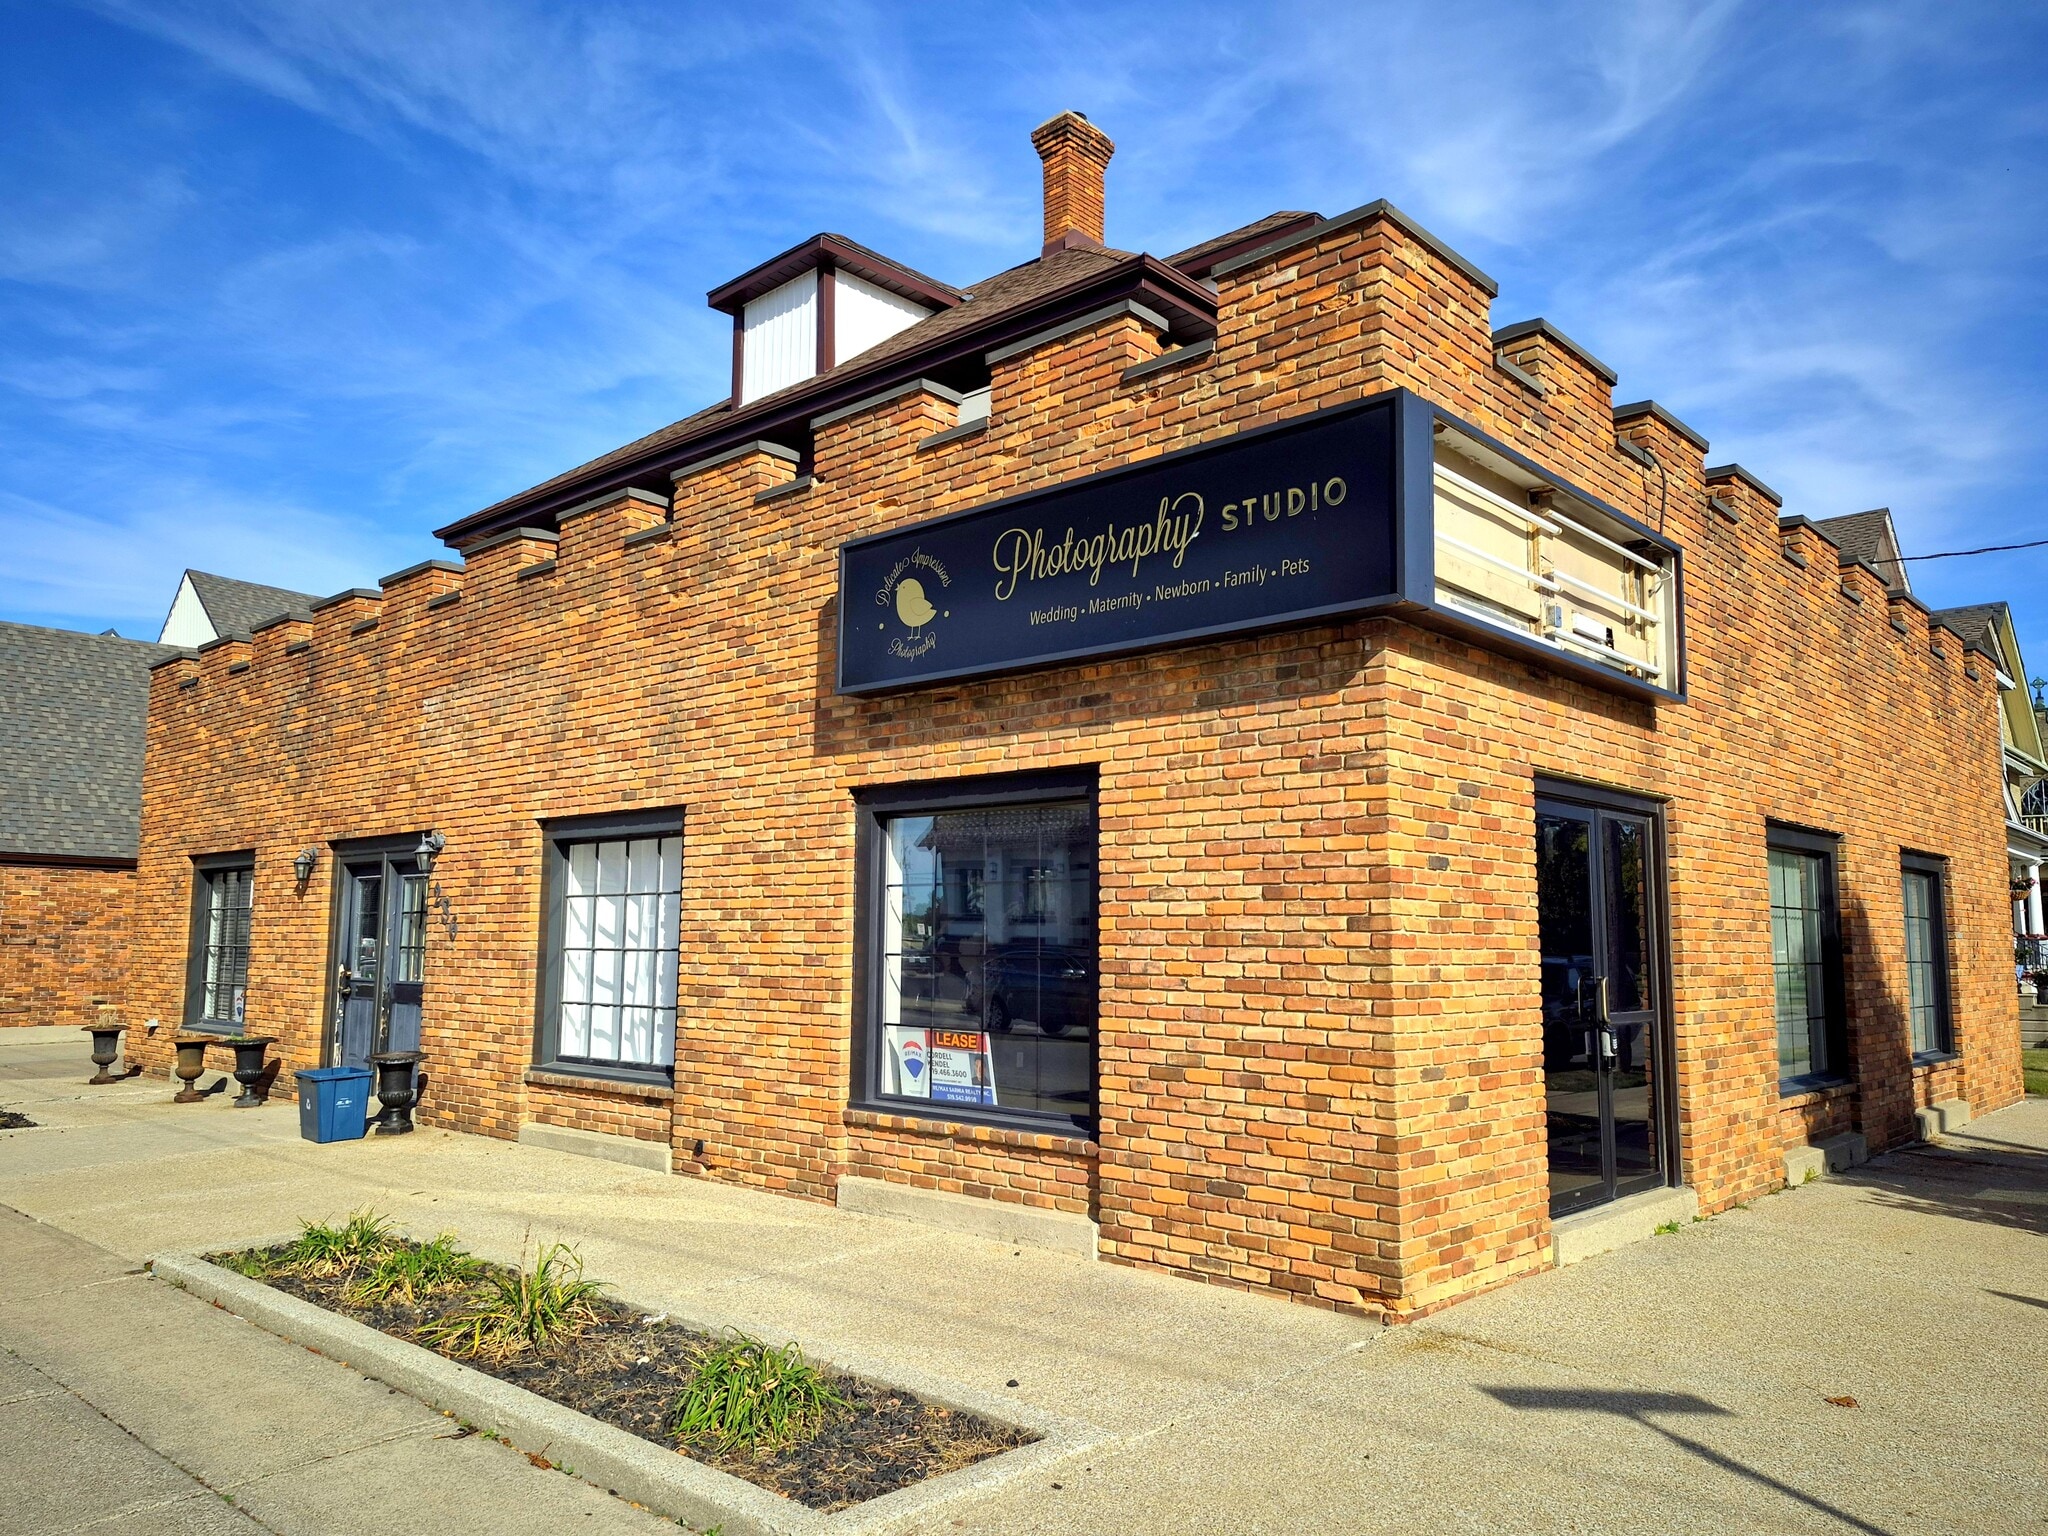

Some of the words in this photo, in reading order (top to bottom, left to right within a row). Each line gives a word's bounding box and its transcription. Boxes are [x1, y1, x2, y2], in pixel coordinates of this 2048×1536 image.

[993, 492, 1204, 600] Photography
[1221, 476, 1347, 531] STUDIO
[875, 557, 909, 607] Delicate
[911, 546, 952, 588] Impressions
[1030, 605, 1077, 626] Wedding
[1089, 592, 1143, 614] Maternity
[1155, 579, 1210, 601] Newborn
[1224, 564, 1267, 588] Family
[1281, 558, 1310, 577] Pets
[887, 631, 936, 662] Photography
[936, 1032, 977, 1048] LEASE
[904, 1050, 922, 1058] RE/MAX
[926, 1051, 952, 1060] CORDELL
[929, 1068, 967, 1078] 19.466.3600
